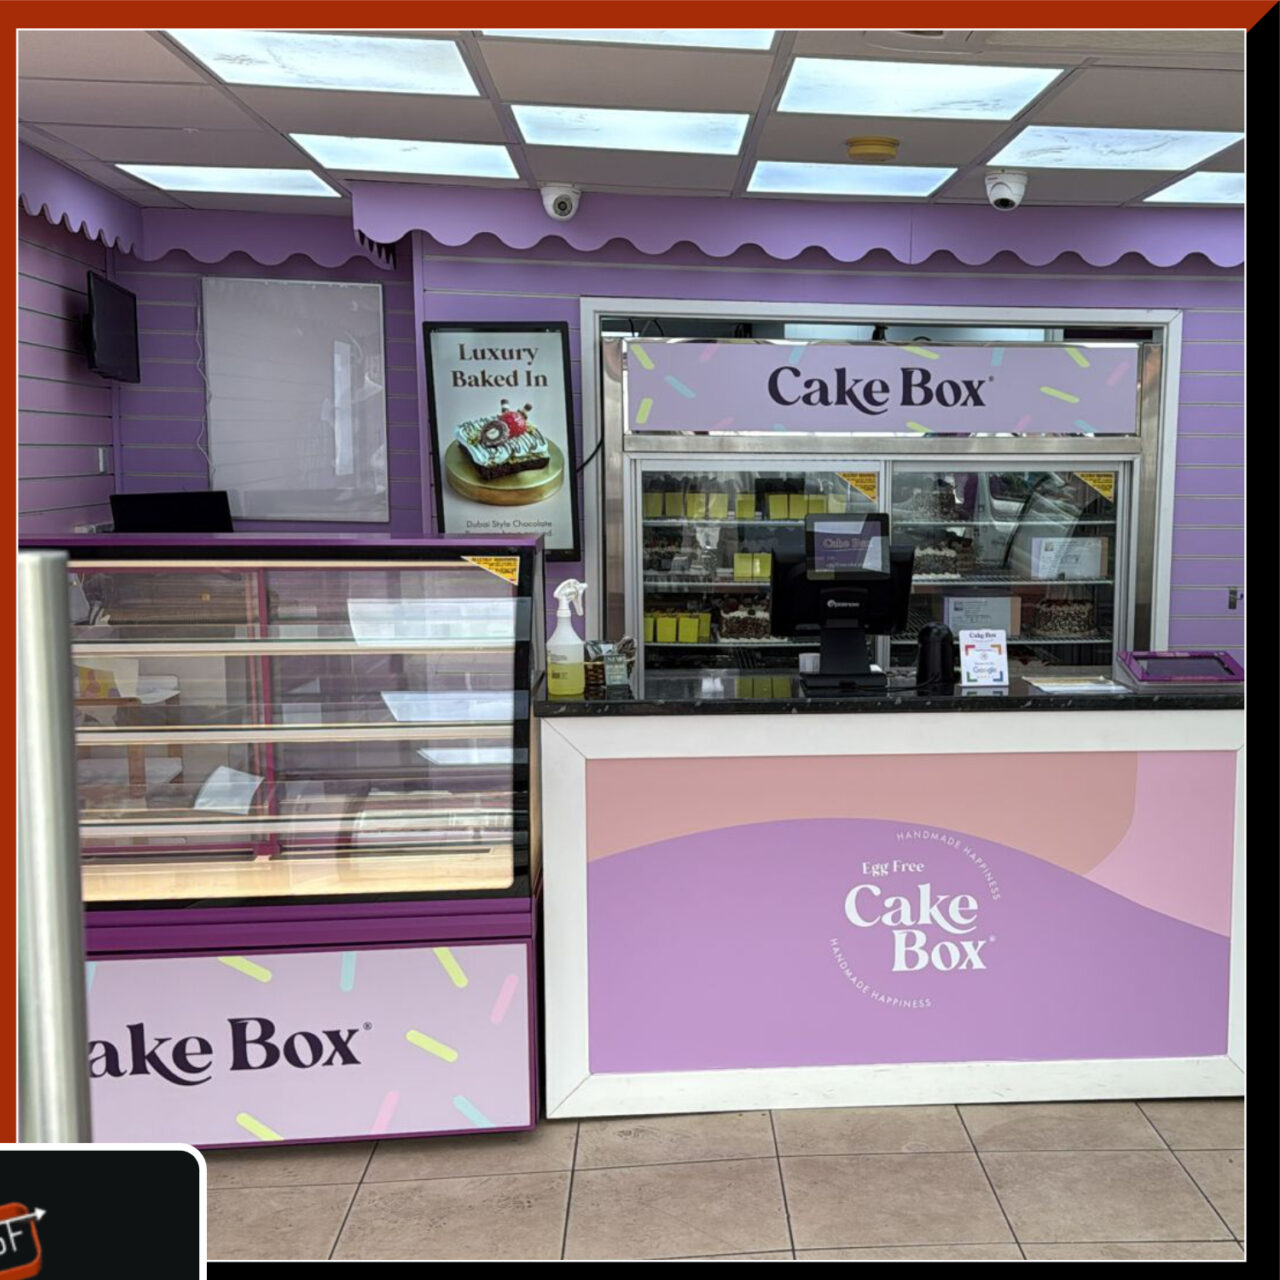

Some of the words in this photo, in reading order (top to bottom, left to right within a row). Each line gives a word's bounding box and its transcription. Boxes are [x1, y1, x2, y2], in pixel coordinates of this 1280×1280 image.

[458, 343, 539, 365] Luxury
[451, 369, 519, 388] Baked
[525, 370, 549, 387] In
[768, 366, 890, 416] Cake
[900, 367, 986, 407] Box
[466, 520, 490, 528] Dubai
[492, 520, 510, 530] Style
[512, 519, 552, 528] Chocolate
[862, 861, 889, 877] Egg
[893, 859, 925, 872] Free
[896, 830, 962, 849] HANDMADE
[963, 846, 1001, 900] HAPPINESS
[845, 883, 978, 934] Cake
[829, 938, 870, 994] HANDMADE
[871, 991, 932, 1008] HAPPINESS
[892, 929, 987, 972] Box
[88, 1022, 213, 1086] ake
[226, 1017, 362, 1071] Box
